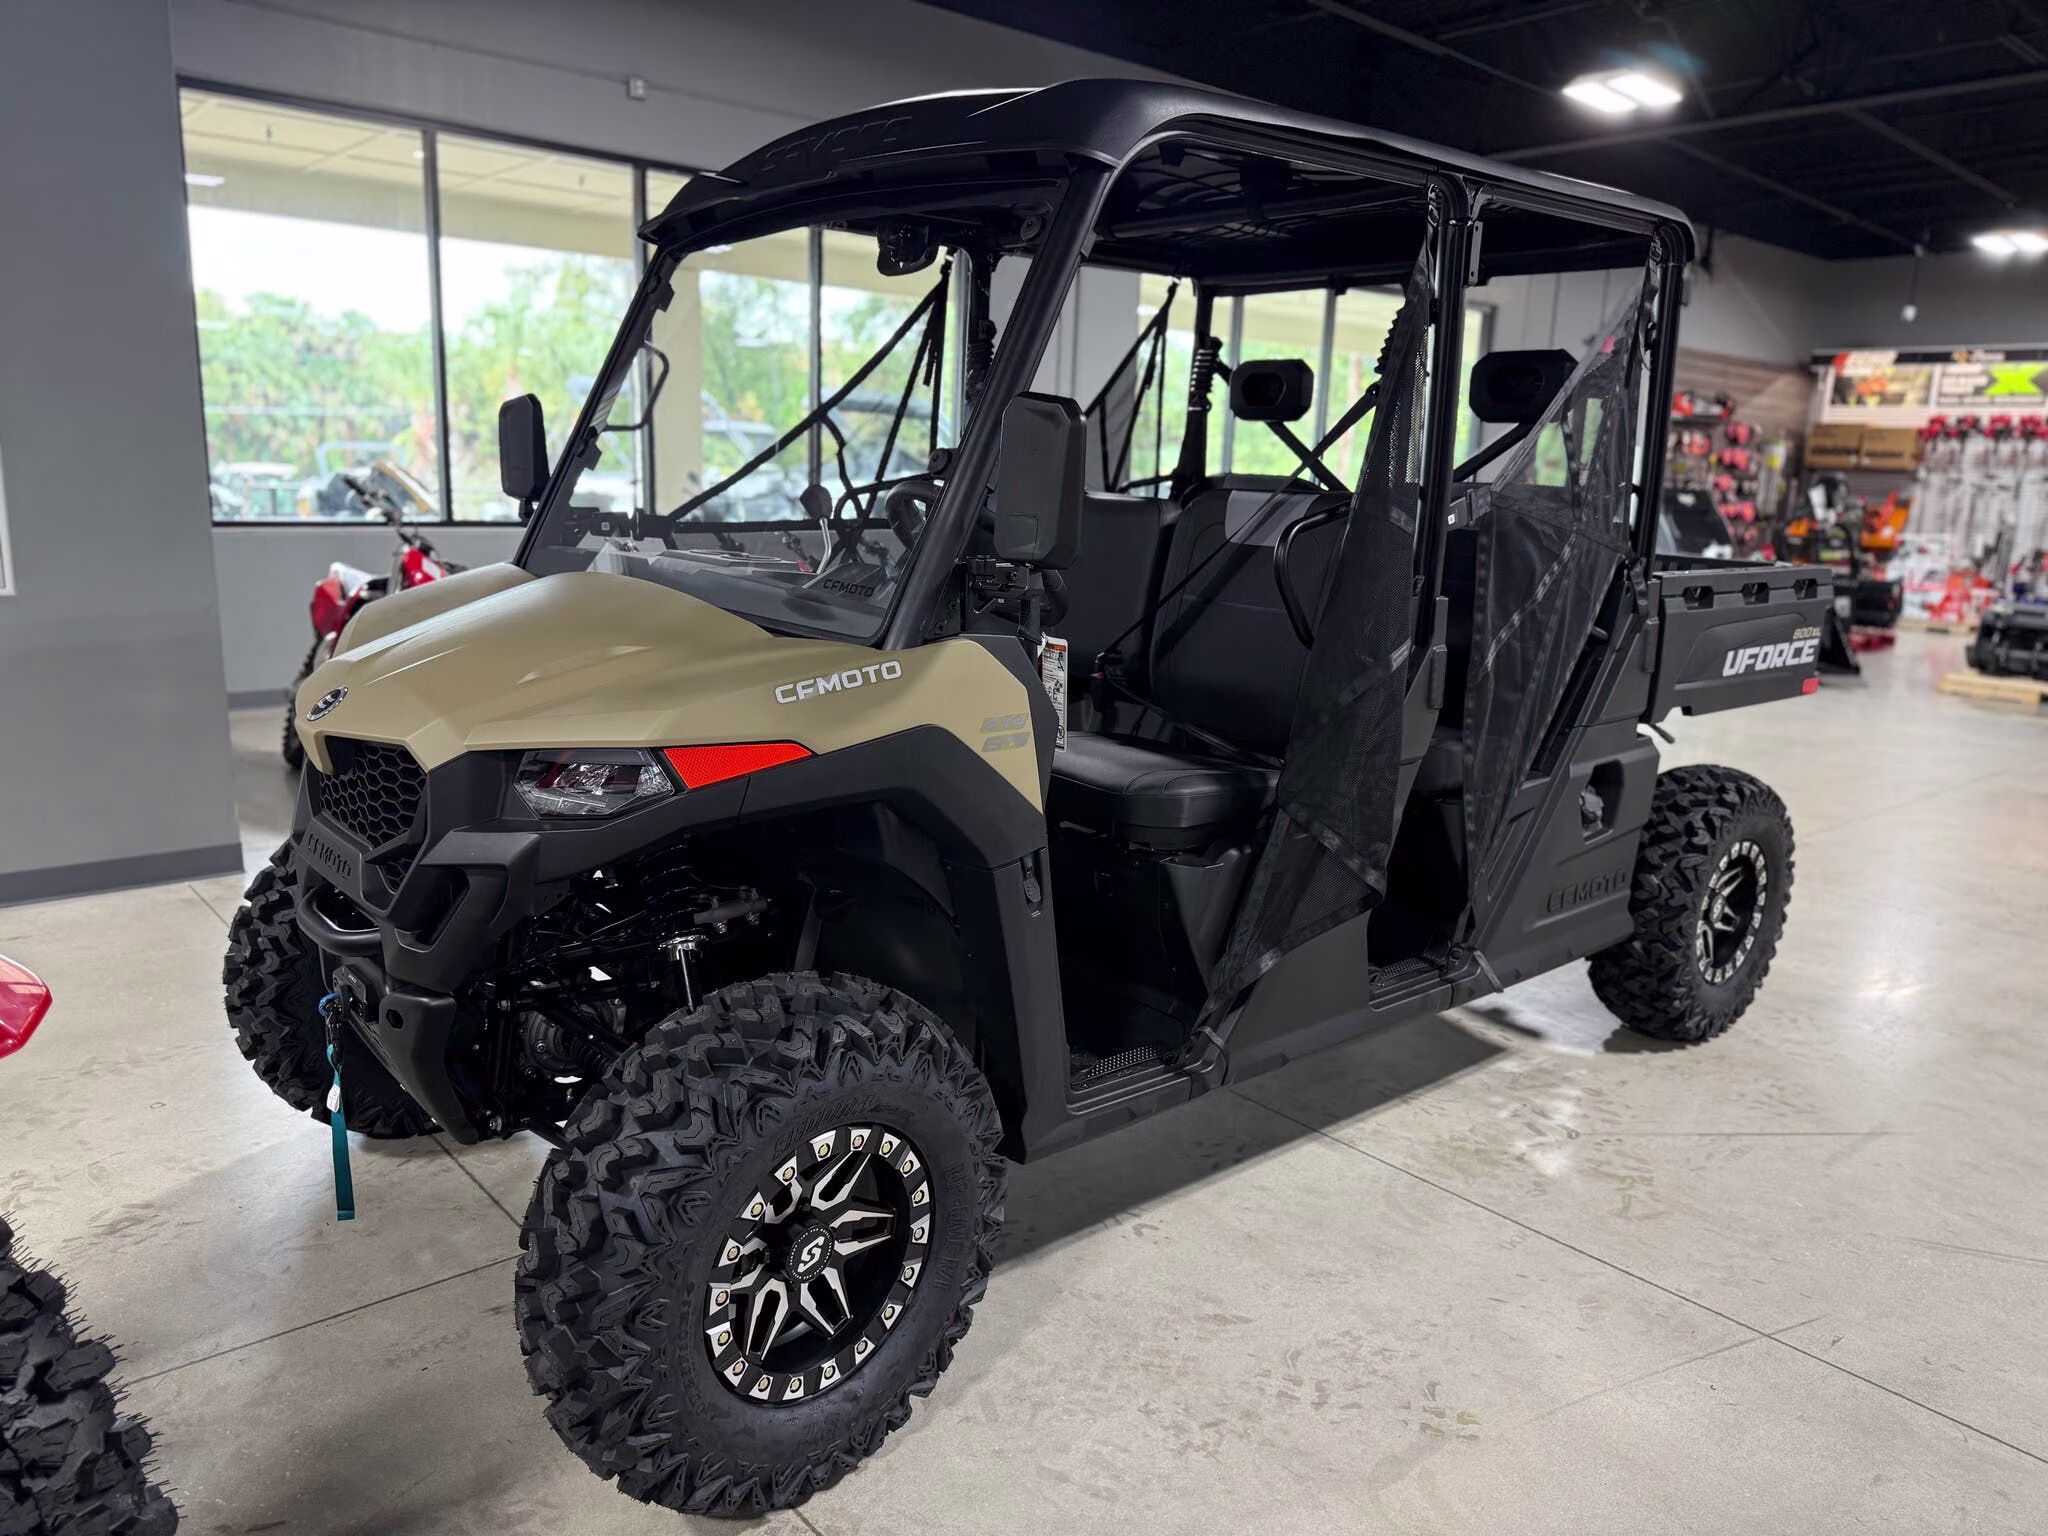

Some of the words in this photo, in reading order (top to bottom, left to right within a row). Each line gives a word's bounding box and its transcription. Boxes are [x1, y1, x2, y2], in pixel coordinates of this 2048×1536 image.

[823, 578, 876, 598] CFMOTO
[1722, 638, 1820, 677] UFORCE
[775, 660, 902, 704] CFMOTO
